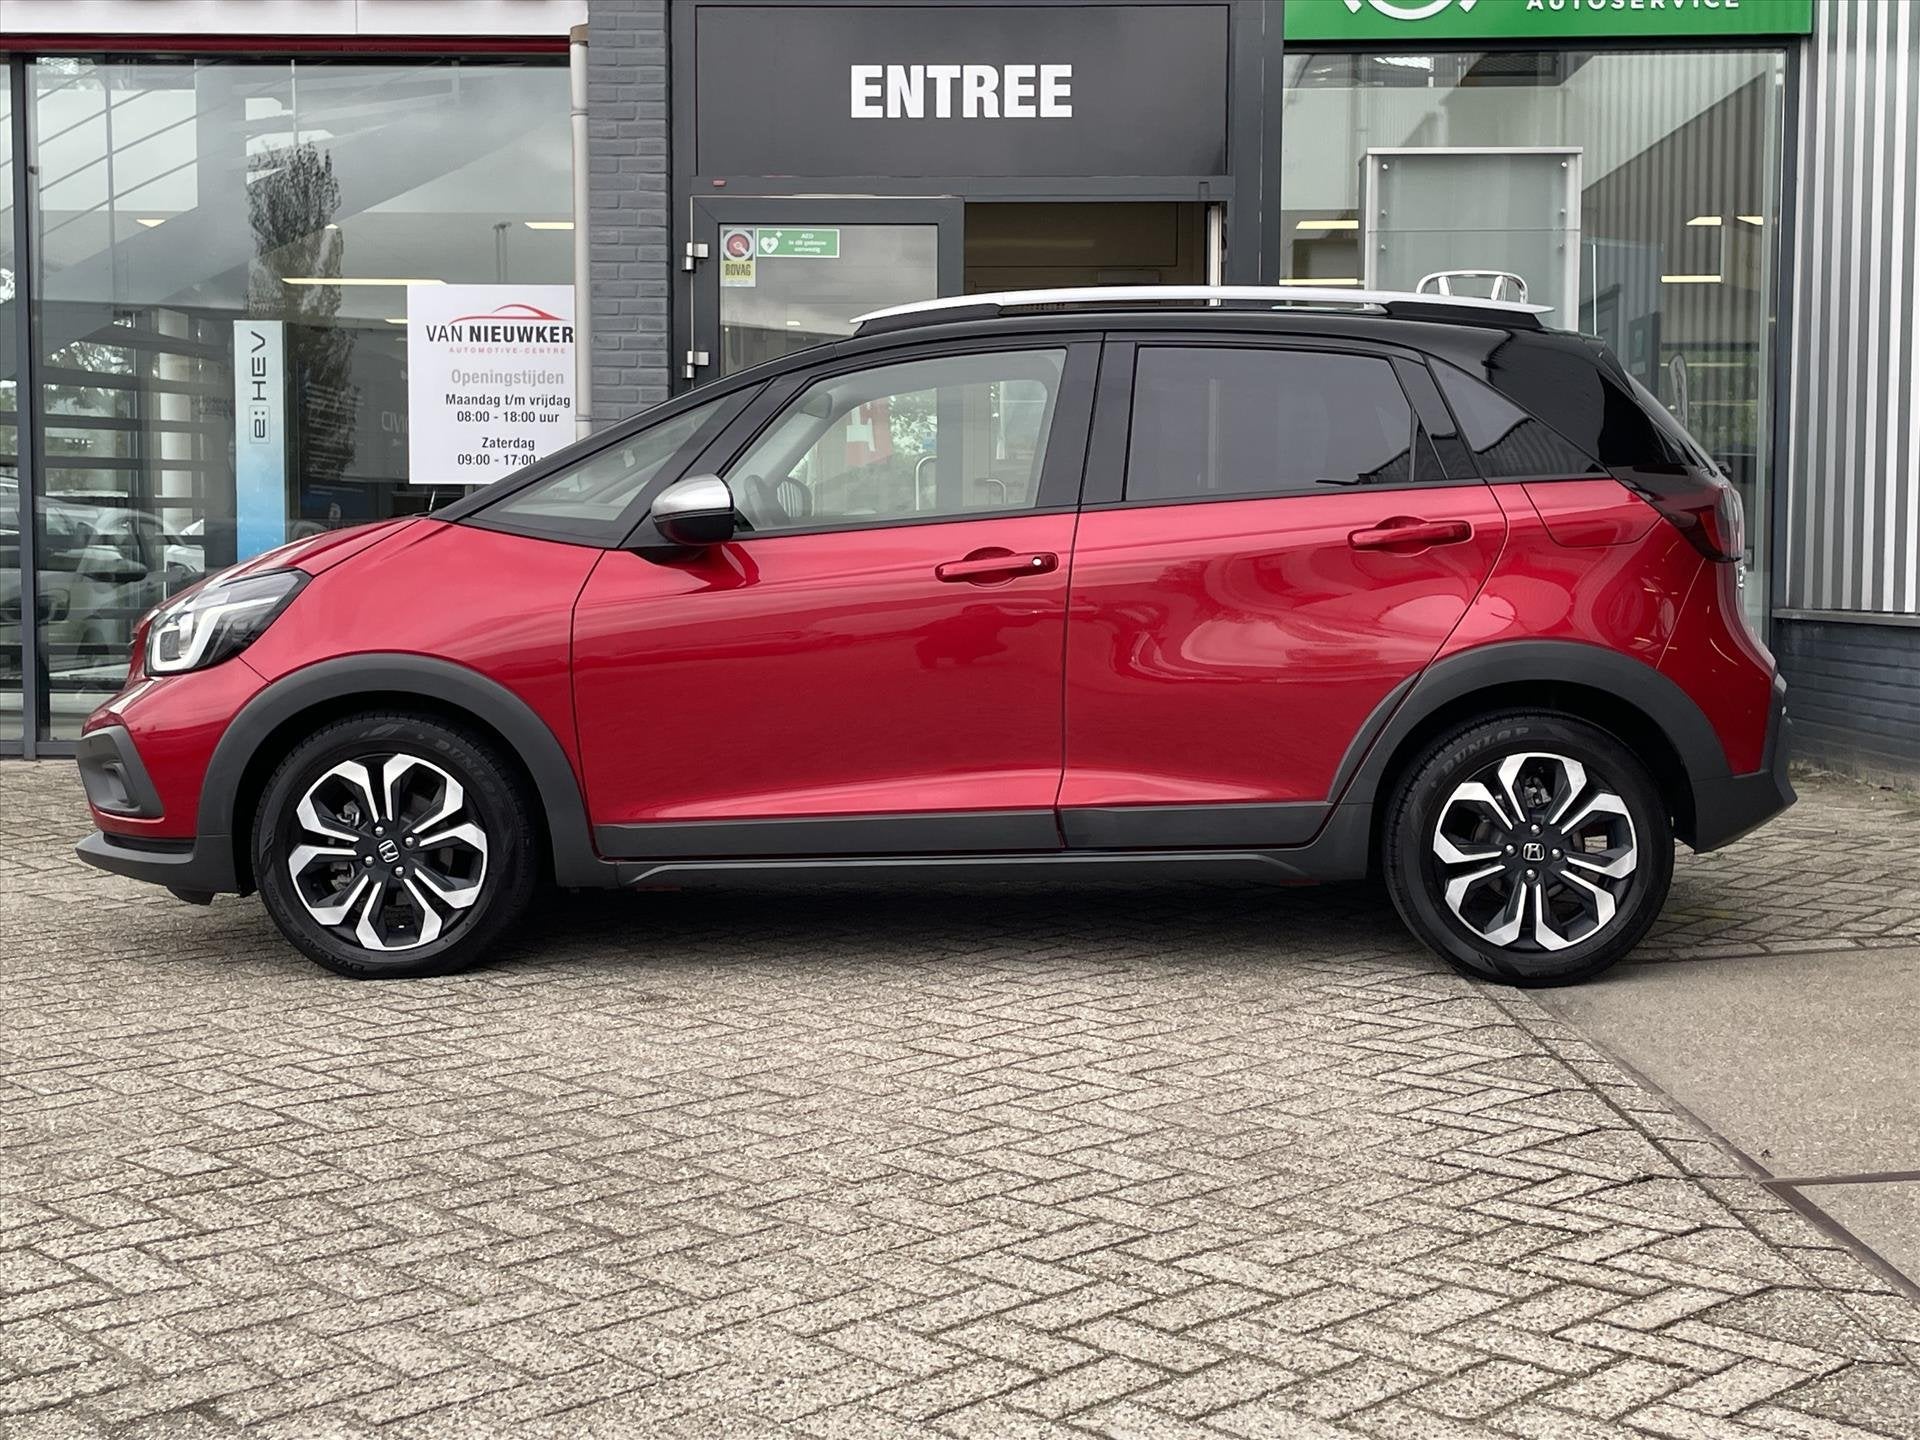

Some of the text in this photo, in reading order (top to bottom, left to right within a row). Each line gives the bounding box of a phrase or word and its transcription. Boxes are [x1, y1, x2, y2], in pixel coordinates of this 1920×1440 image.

[851, 64, 1072, 118] ENTREE
[725, 263, 751, 276] BOVAG
[426, 325, 574, 343] VAN NIEUWKER
[451, 369, 564, 386] Openingstijden
[446, 394, 571, 408] Maandag t/m vrijdag
[457, 411, 490, 422] 08:00
[503, 411, 536, 422] 18:00
[539, 414, 560, 422] uur
[482, 437, 535, 450] Zaterdag
[457, 454, 490, 465] 09:00
[503, 454, 536, 465] 17:00
